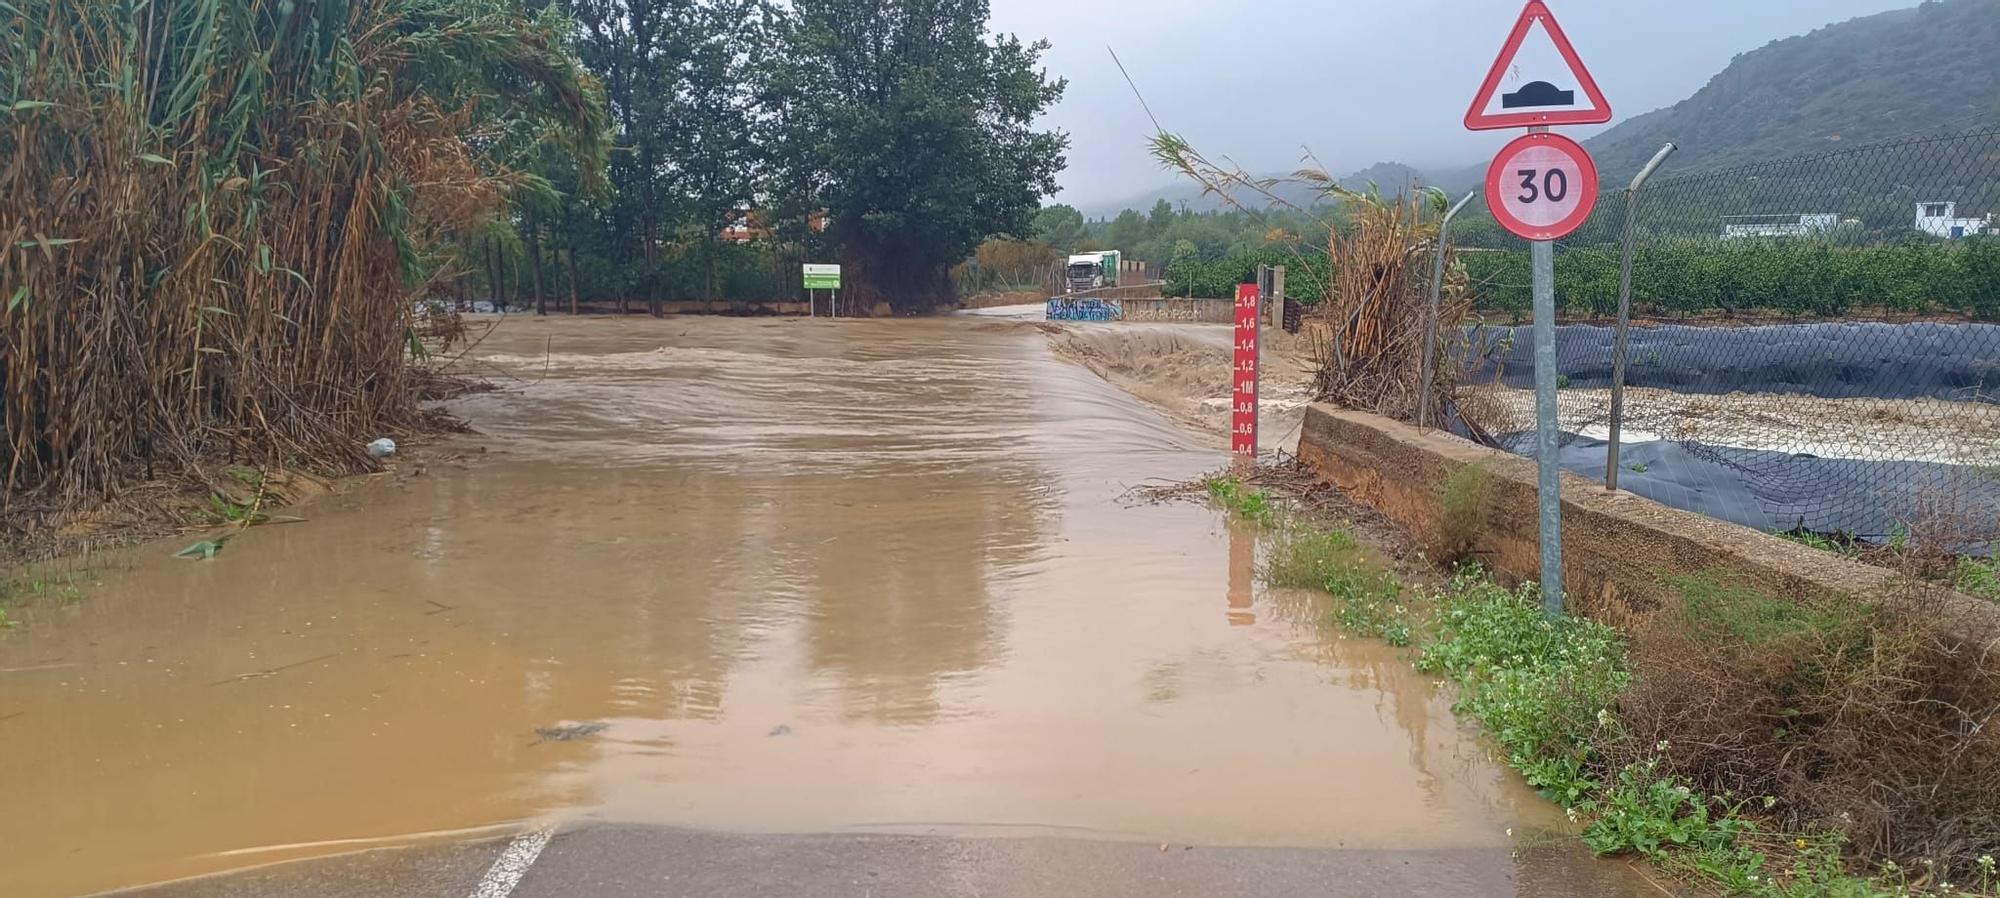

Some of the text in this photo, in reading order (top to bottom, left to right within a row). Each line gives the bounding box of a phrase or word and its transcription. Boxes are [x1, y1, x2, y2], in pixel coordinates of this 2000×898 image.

[1518, 168, 1567, 203] 30
[1243, 296, 1255, 308] 1,8
[1242, 318, 1255, 328] 1,6
[1242, 339, 1254, 350] 1,4
[1241, 360, 1253, 371] 1,2
[1241, 381, 1253, 393] 1M
[1240, 402, 1252, 413] 0,8
[1240, 424, 1252, 434] 0,6
[1239, 445, 1252, 456] 0,4
